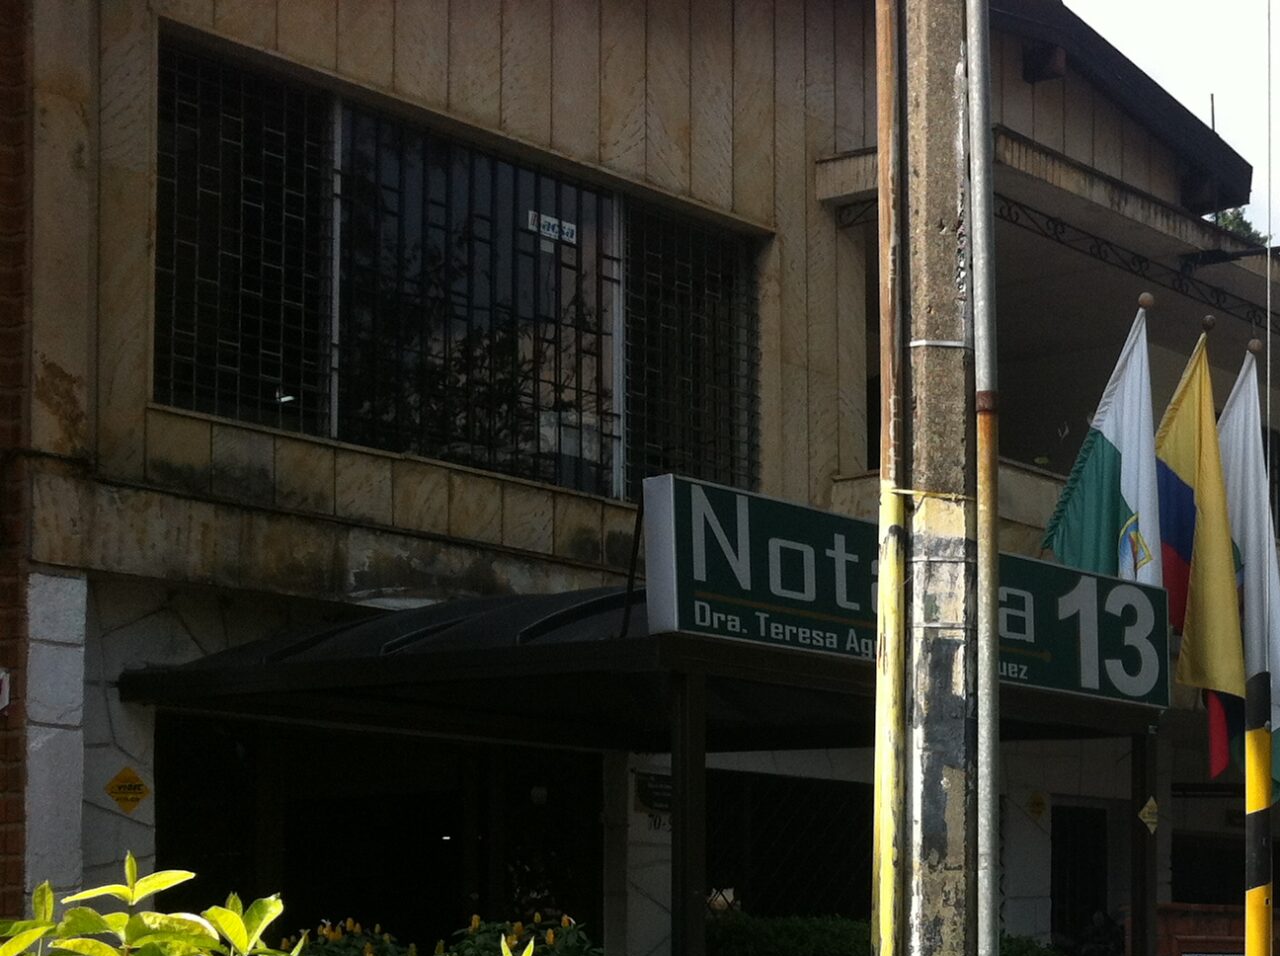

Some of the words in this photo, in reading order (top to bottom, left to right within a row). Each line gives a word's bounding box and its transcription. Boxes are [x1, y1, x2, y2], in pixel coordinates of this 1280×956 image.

[693, 600, 748, 634] Dra.
[755, 611, 838, 649] Teresa
[1058, 574, 1160, 697] 13
